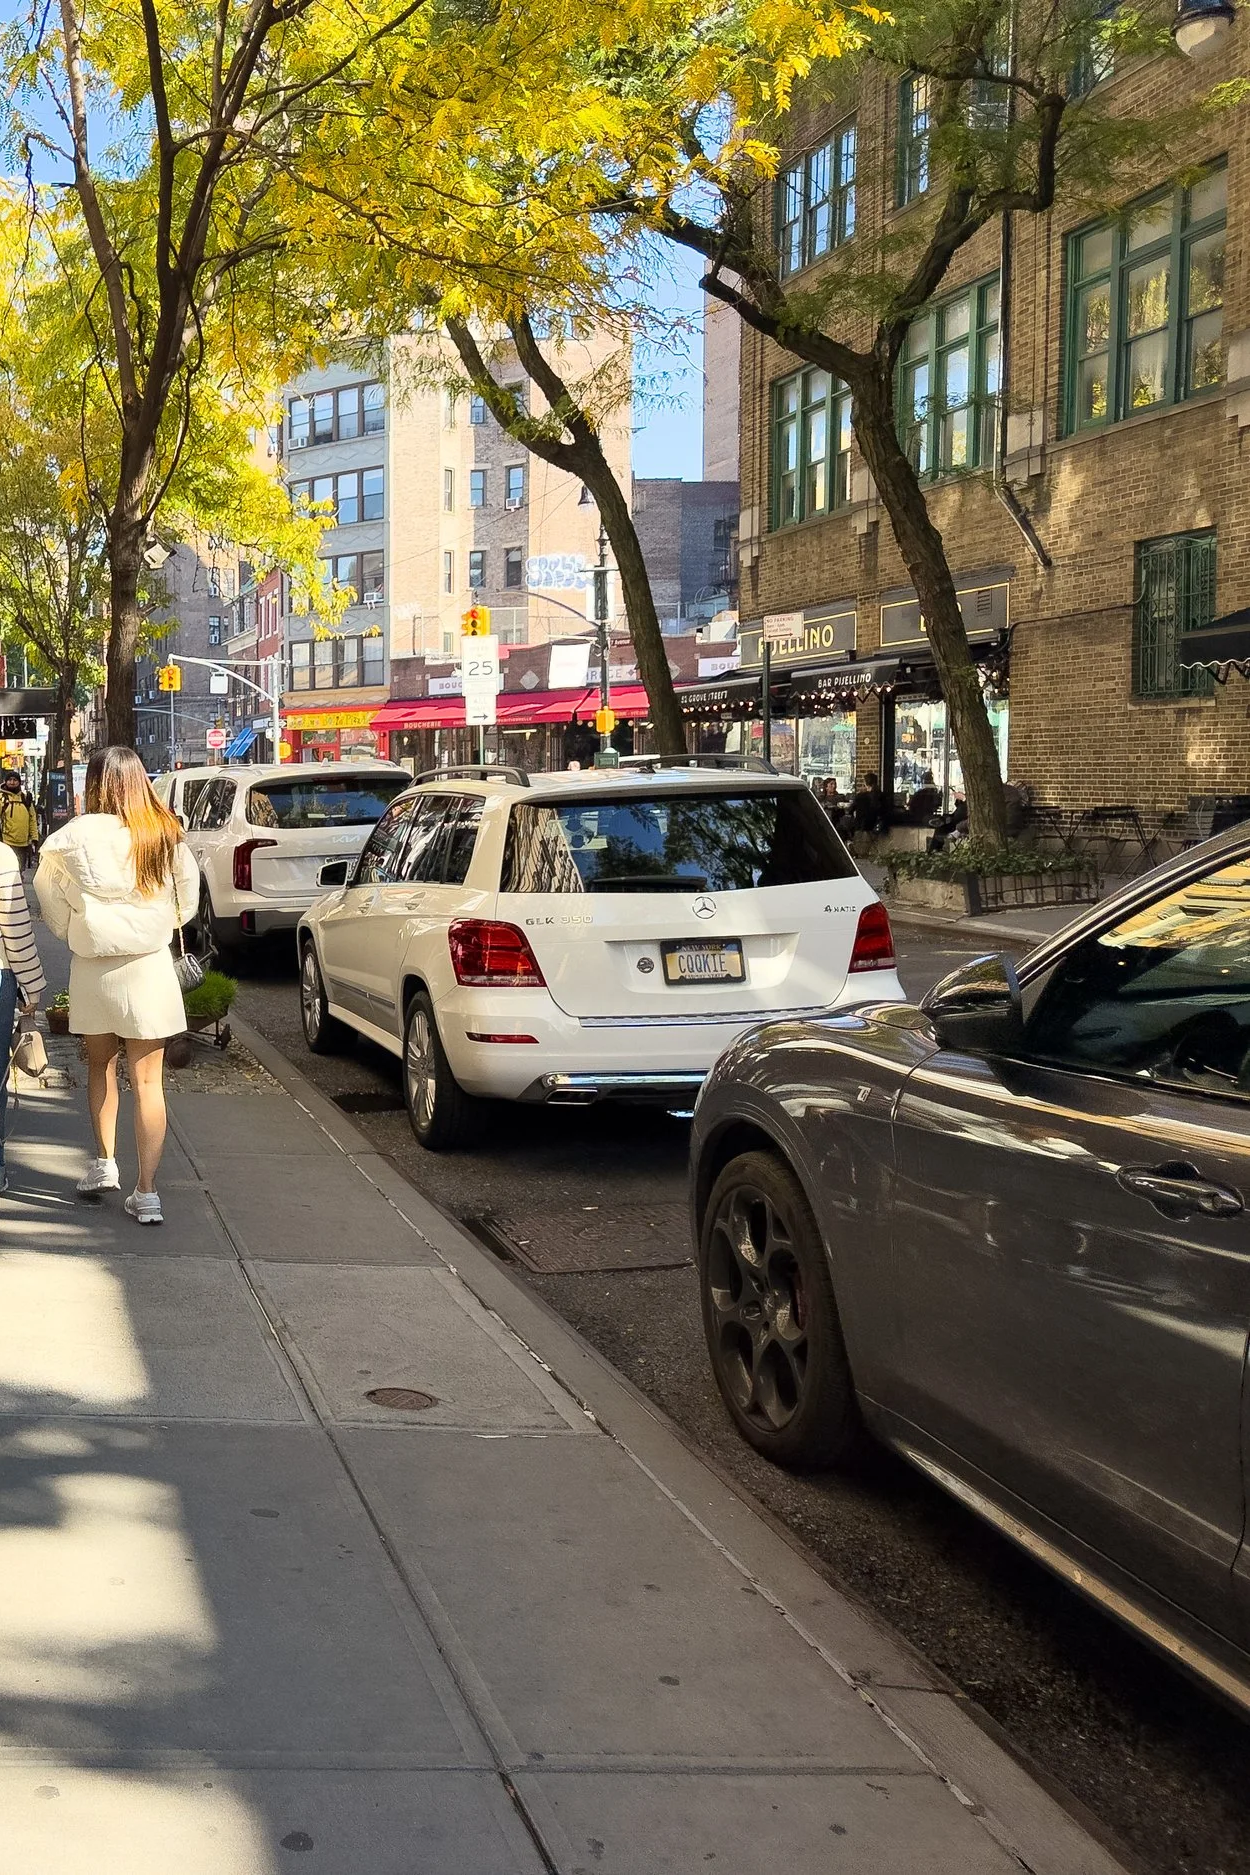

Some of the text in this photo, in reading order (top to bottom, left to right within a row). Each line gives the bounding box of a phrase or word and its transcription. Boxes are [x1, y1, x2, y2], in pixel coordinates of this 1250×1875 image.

[774, 615, 795, 623] PARKING
[468, 660, 494, 676] 25
[817, 672, 872, 689] BAR PISELLINO
[688, 693, 707, 703] GROVE
[707, 690, 728, 701] STREET
[403, 720, 442, 729] BOUCHERIE
[57, 783, 66, 796] P
[525, 914, 594, 926] GLK 350
[681, 943, 722, 953] NEW YORK
